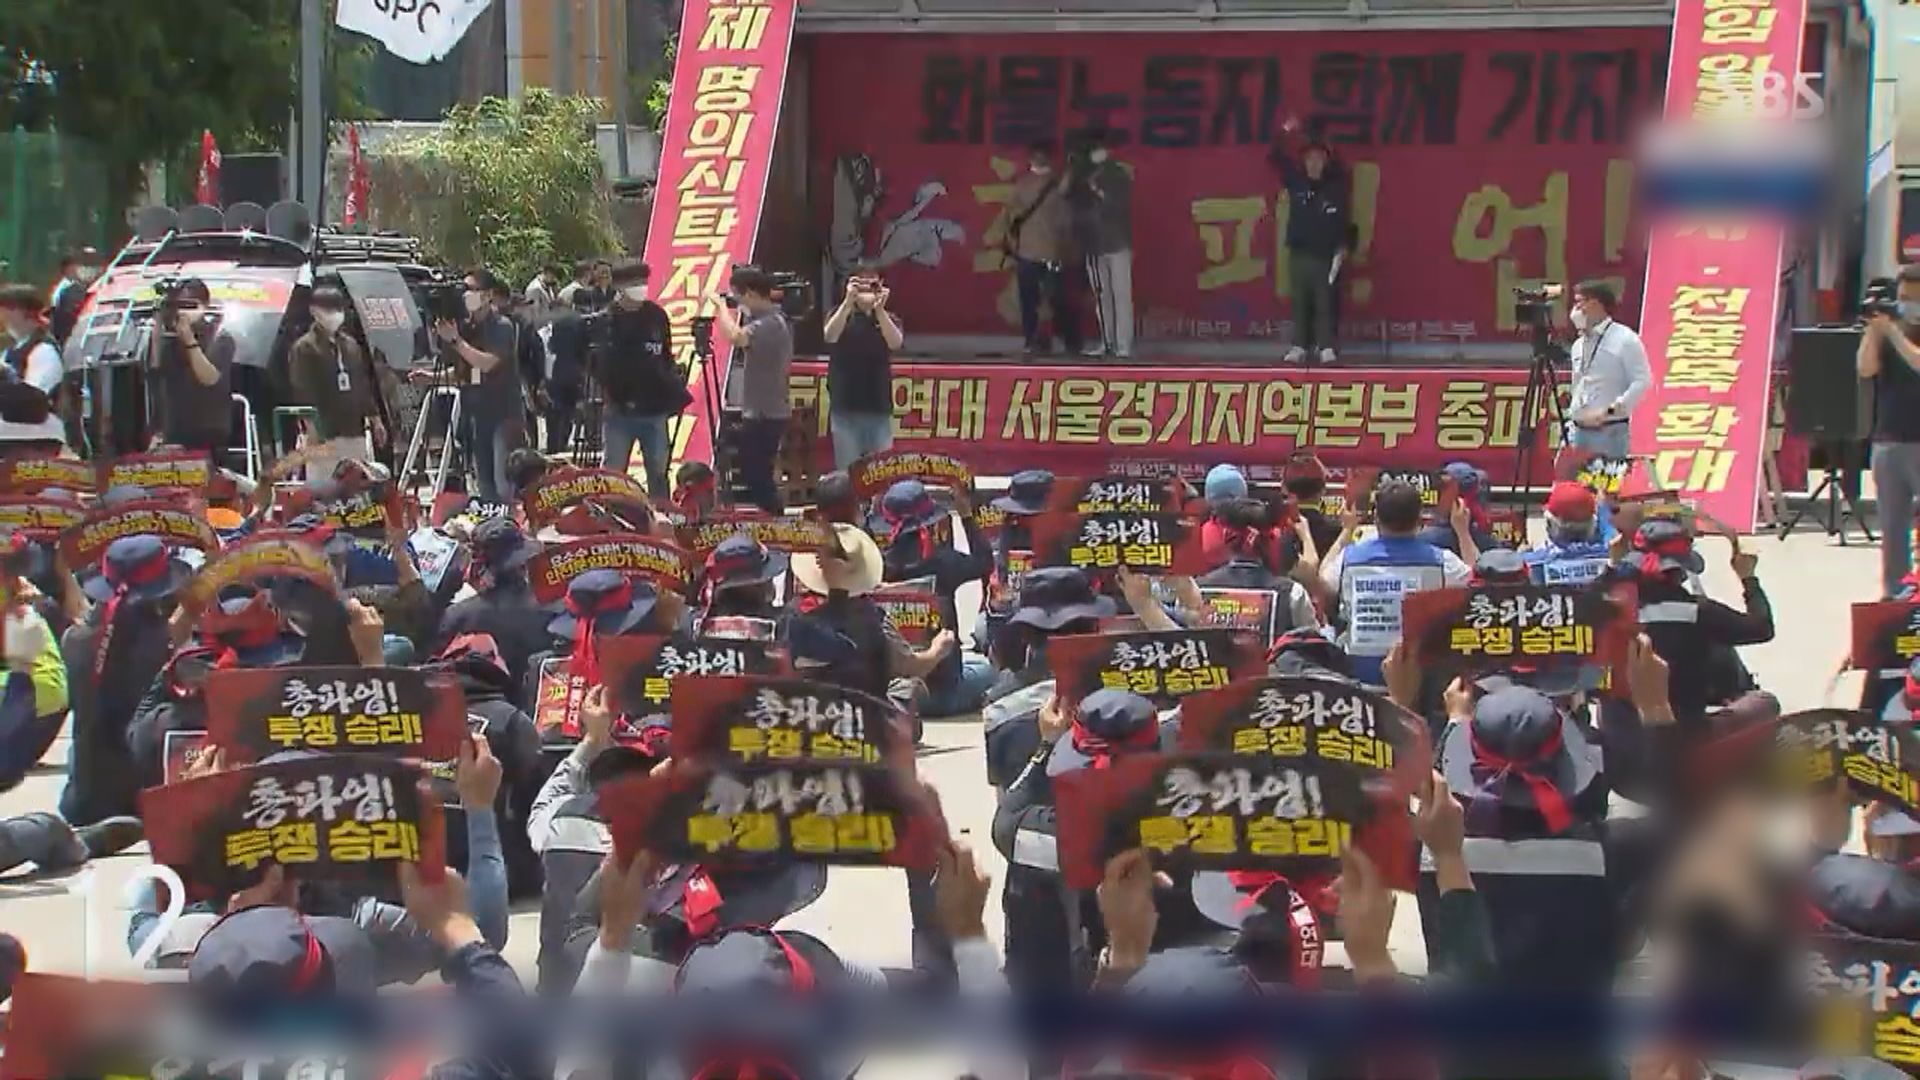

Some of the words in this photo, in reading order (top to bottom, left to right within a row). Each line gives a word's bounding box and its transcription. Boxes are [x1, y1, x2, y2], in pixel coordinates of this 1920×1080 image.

[1002, 378, 1420, 450] 서울경기지역본부
[1655, 402, 1740, 493] 확대
[1123, 543, 1174, 567] 승리!
[1449, 628, 1514, 657] 투쟁
[1520, 625, 1594, 655] 승리!
[281, 678, 399, 717] 총파업!
[1099, 669, 1160, 698] 투쟁
[1164, 666, 1230, 695] 승리!
[266, 715, 337, 746] 투쟁
[345, 711, 424, 746] 승리!
[1248, 688, 1377, 736] 총파업!
[1231, 726, 1308, 757] 투쟁
[1316, 728, 1395, 770] 승리!
[242, 771, 398, 830] 총파업!
[1156, 766, 1326, 820] 총파업!
[225, 825, 318, 870] 투쟁
[328, 821, 421, 863] 승리!
[1246, 815, 1353, 858] 승리!
